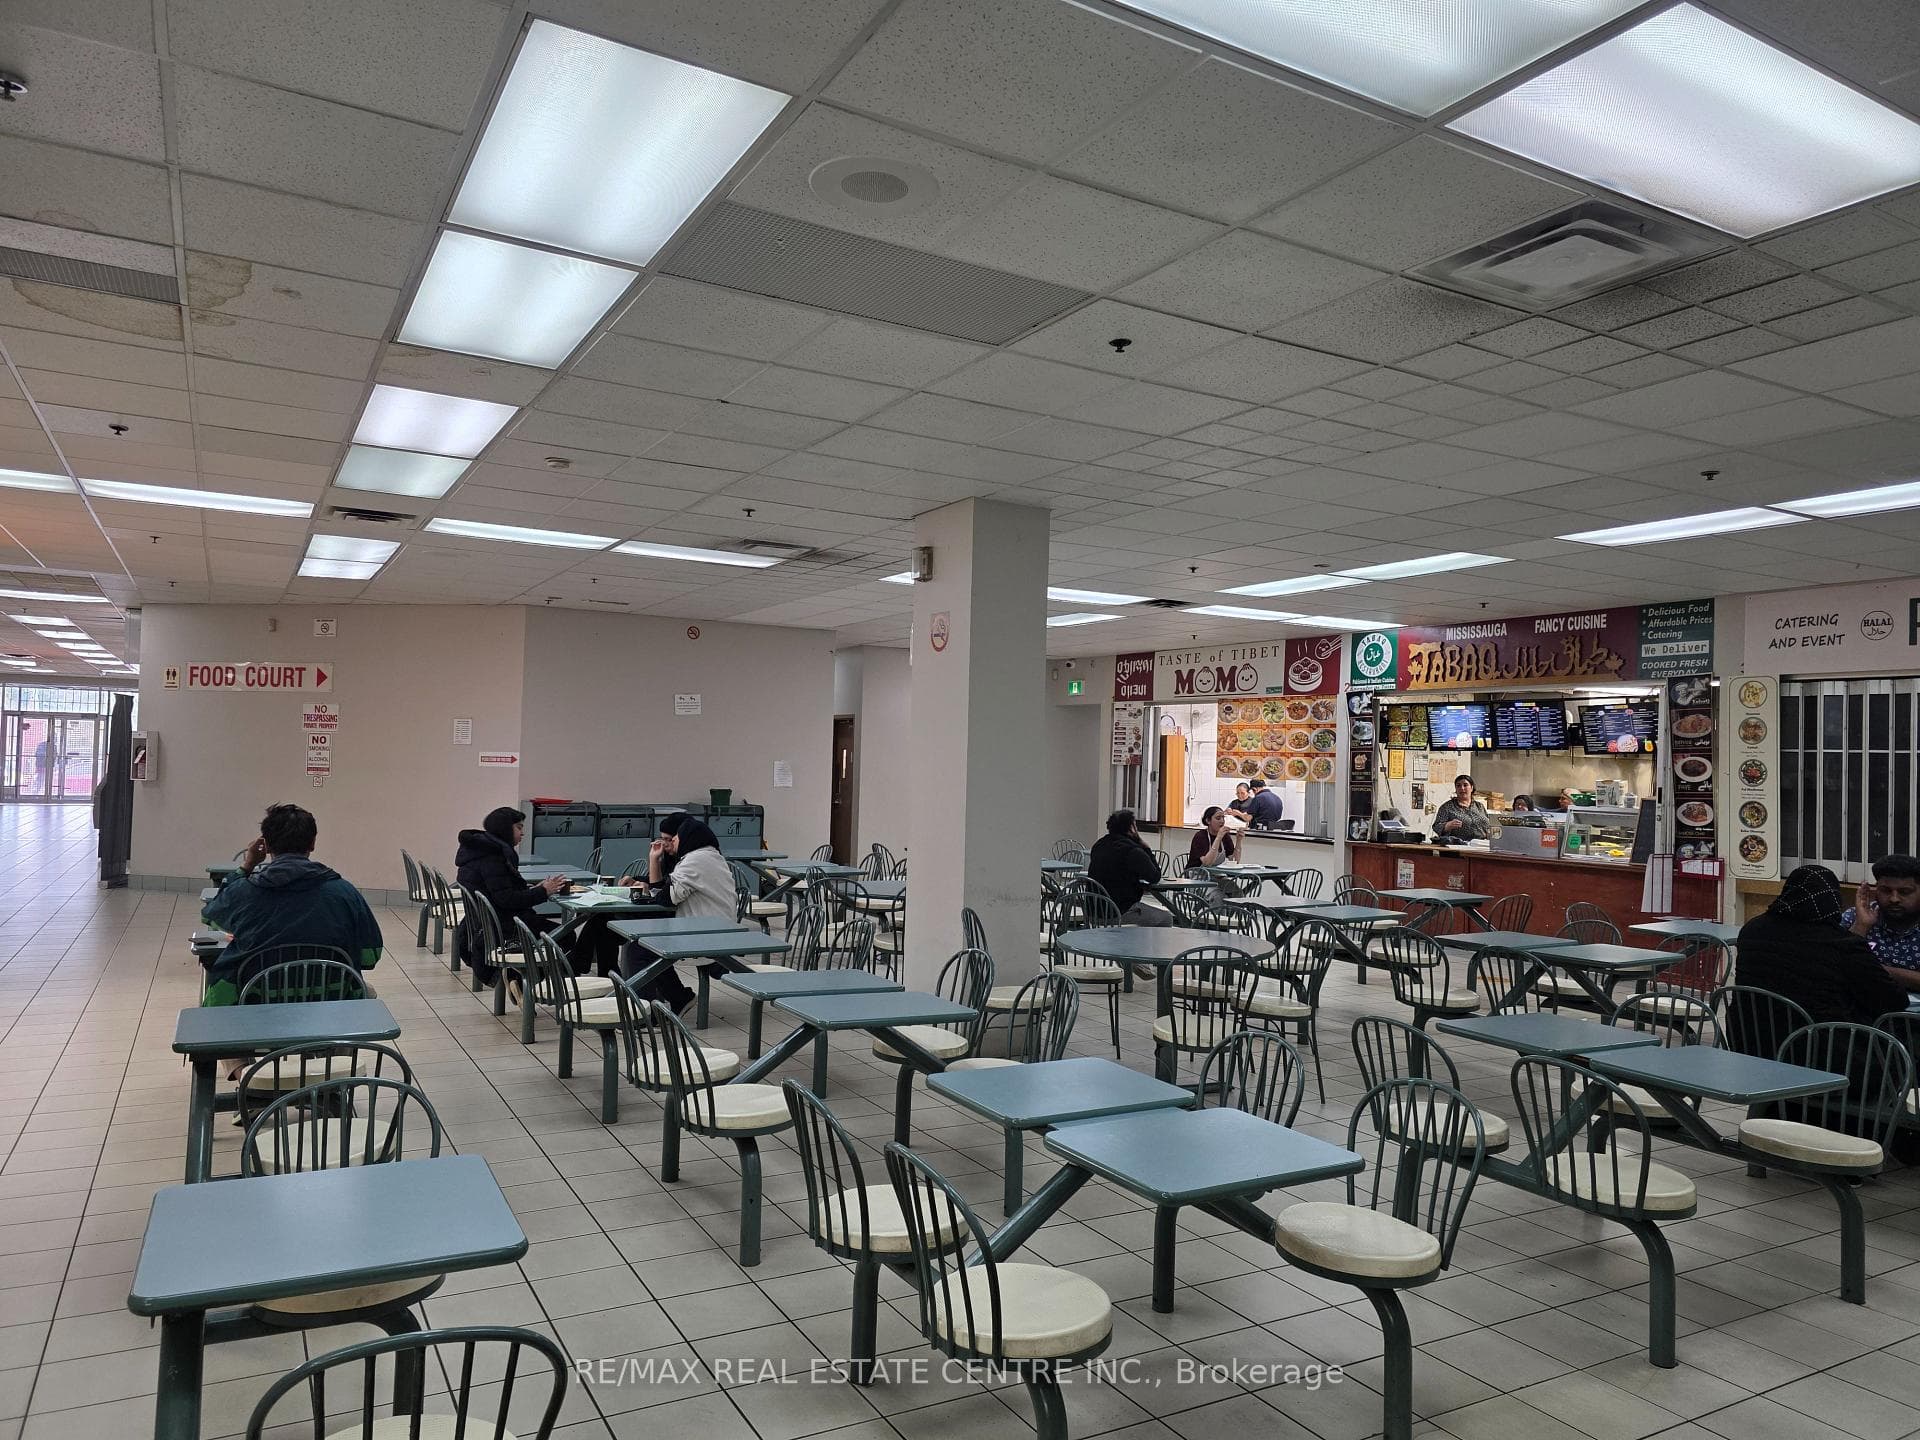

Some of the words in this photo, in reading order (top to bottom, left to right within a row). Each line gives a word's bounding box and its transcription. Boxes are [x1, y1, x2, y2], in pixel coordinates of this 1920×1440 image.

[1648, 607, 1685, 616] Delicious
[1688, 603, 1710, 613] Food
[1535, 616, 1565, 634] FANCY
[1568, 614, 1607, 631] CUISINE
[1648, 617, 1688, 628] Affordable
[1690, 616, 1713, 625] Prices
[1775, 614, 1839, 630] CATERING
[1863, 618, 1893, 627] HALAL
[1446, 623, 1507, 641] MISSISSAUGA
[1648, 630, 1683, 640] Catering
[1867, 627, 1886, 637] حلال
[1768, 637, 1797, 649] AND
[1801, 633, 1845, 647] EVENT
[1644, 646, 1657, 655] We
[1663, 644, 1707, 653] Deliver
[1159, 652, 1201, 666] TASTE
[1209, 650, 1223, 662] of
[1231, 646, 1280, 661] TIBET
[1641, 660, 1678, 670] COOKED
[1679, 659, 1709, 668] FRESH
[189, 665, 236, 687] FOOD
[245, 666, 307, 688] COURT
[1174, 663, 1258, 694] MOMO
[1651, 669, 1698, 679] EVERYDAY
[314, 705, 328, 713] NO
[303, 713, 338, 722] TRESPASSING
[311, 736, 327, 744] NO
